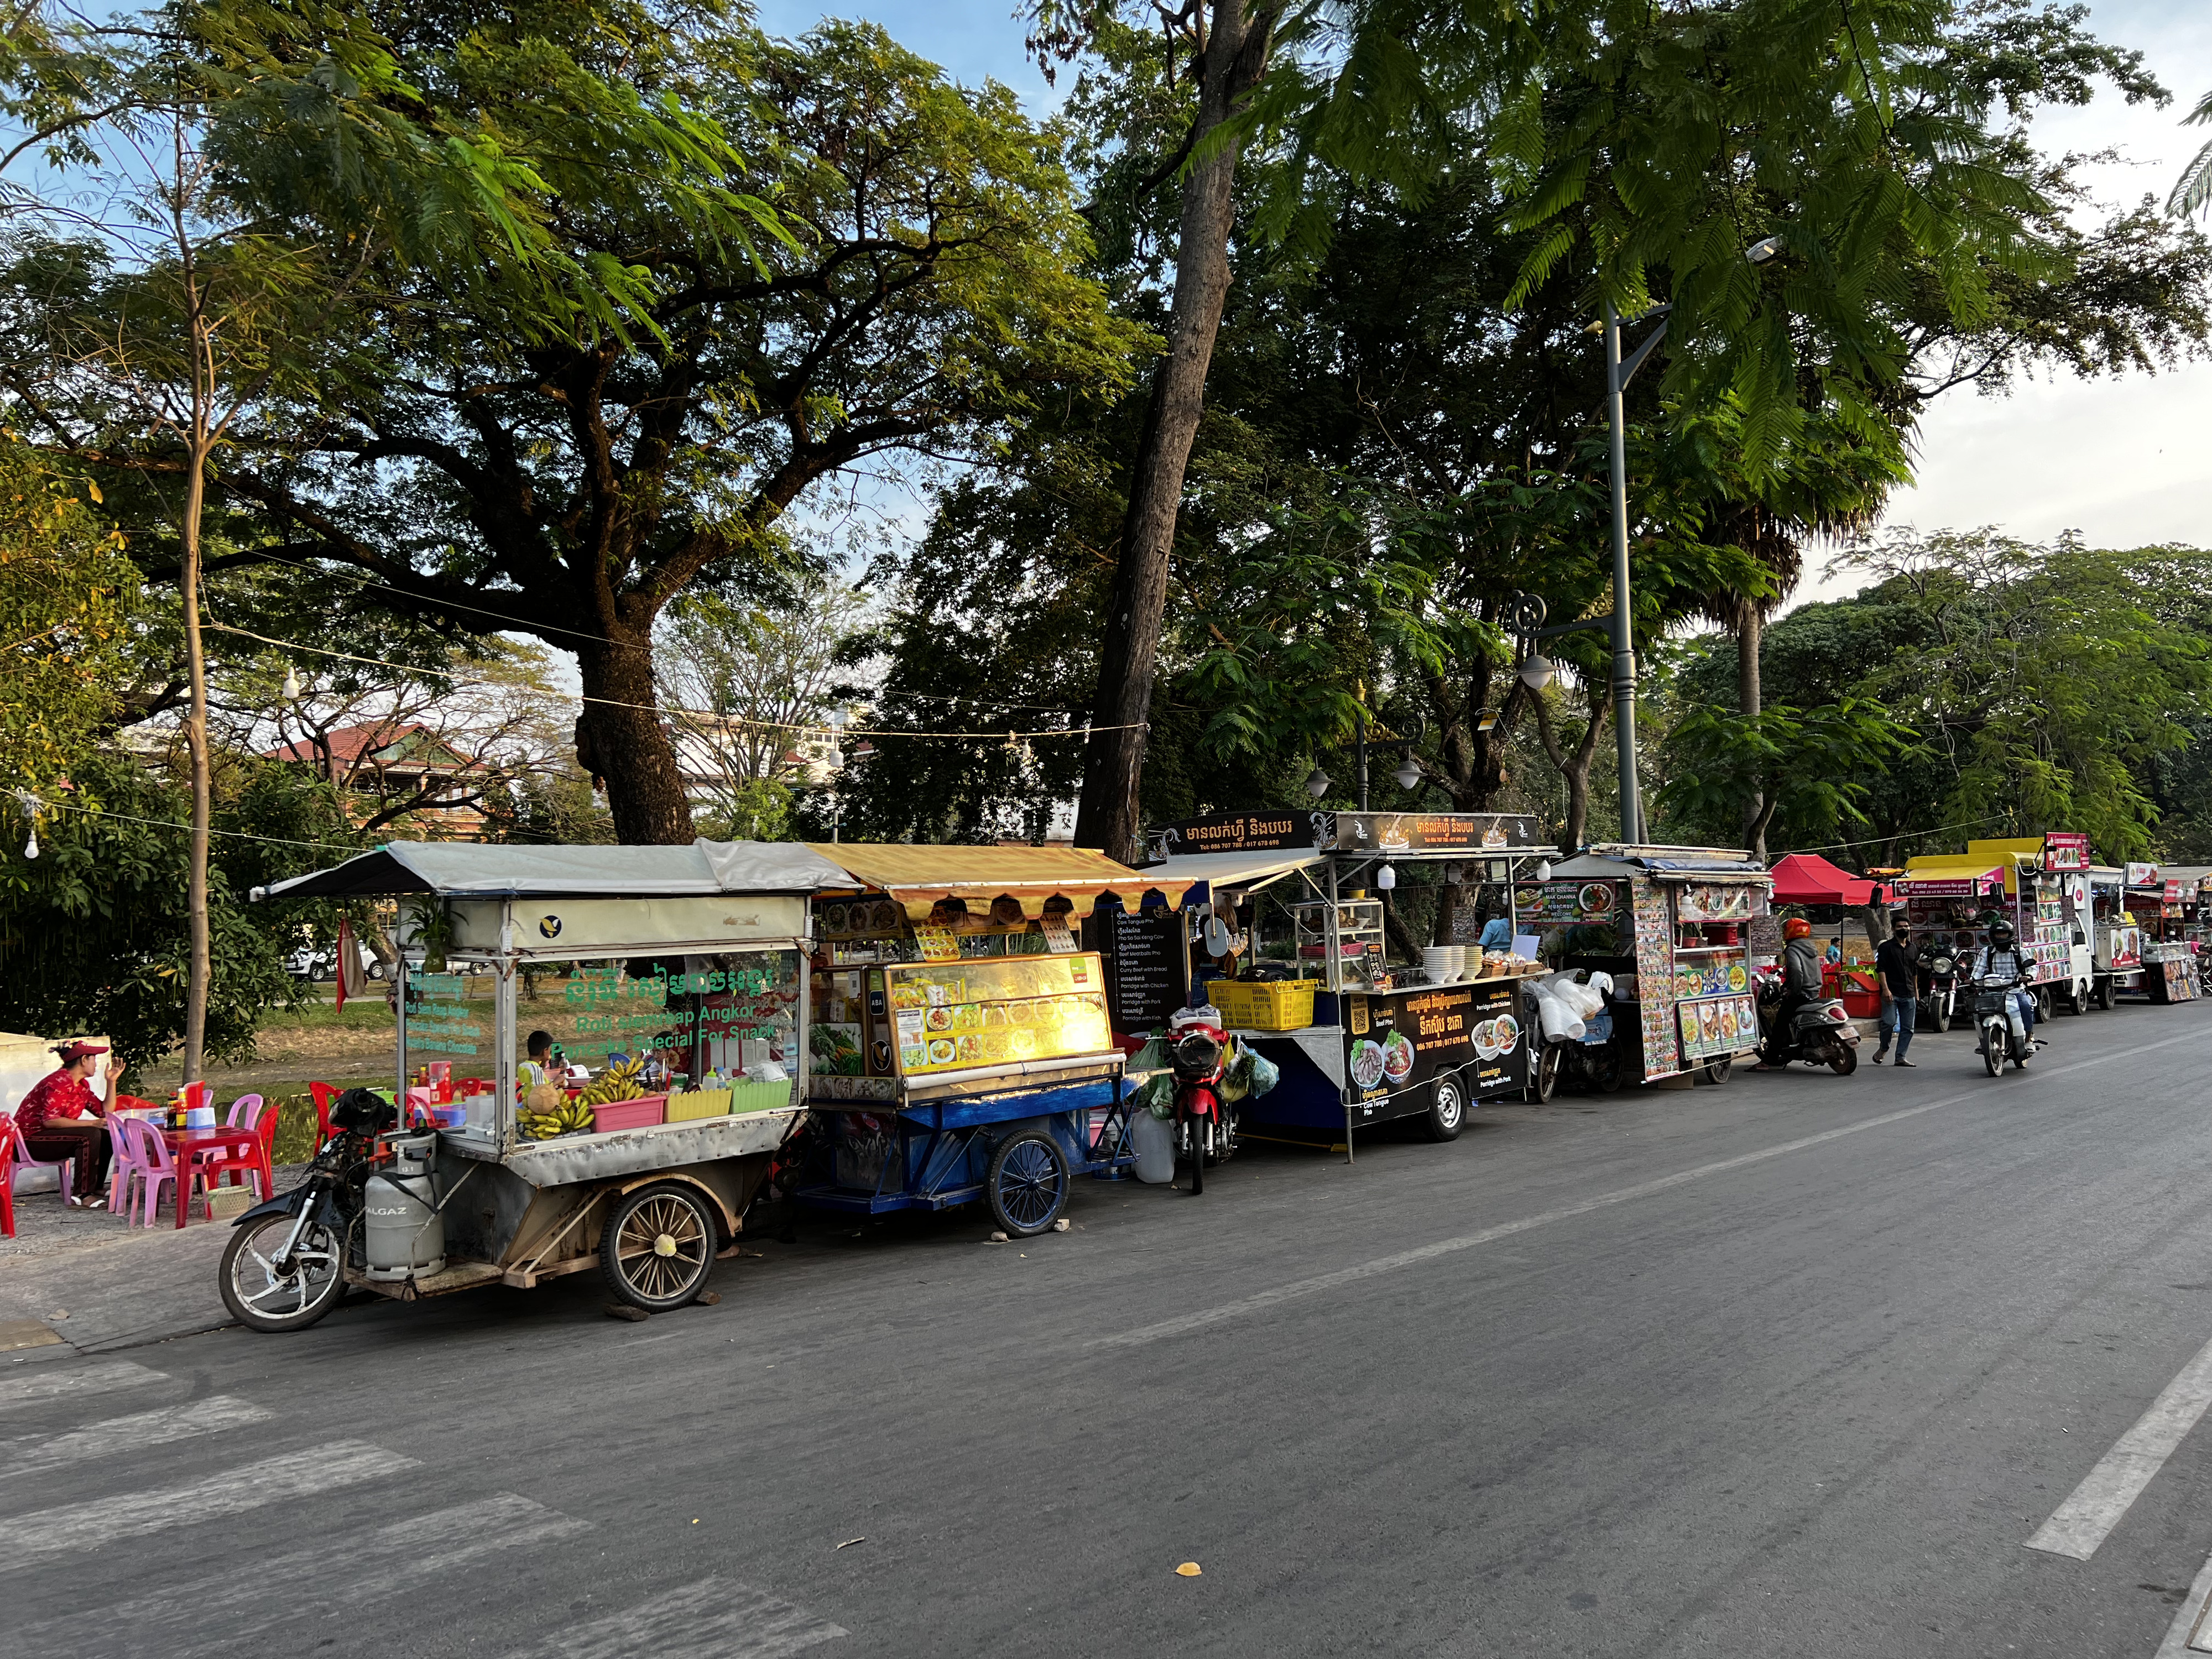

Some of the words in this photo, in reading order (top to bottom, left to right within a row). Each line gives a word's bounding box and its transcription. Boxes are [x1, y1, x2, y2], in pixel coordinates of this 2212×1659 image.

[1250, 818, 1292, 836] និងបបរ
[1451, 818, 1474, 833] និងបបរ
[577, 1015, 612, 1033] Roti
[618, 1011, 695, 1030] siemreap
[698, 1004, 757, 1023] Angkor
[1376, 1019, 1385, 1027] Beef
[551, 1038, 627, 1060] Pancake
[633, 1030, 692, 1051] Special
[699, 1028, 724, 1045] For
[729, 1023, 775, 1041] Snack
[1460, 1035, 1469, 1043] 698
[1373, 1099, 1389, 1107] Tongue
